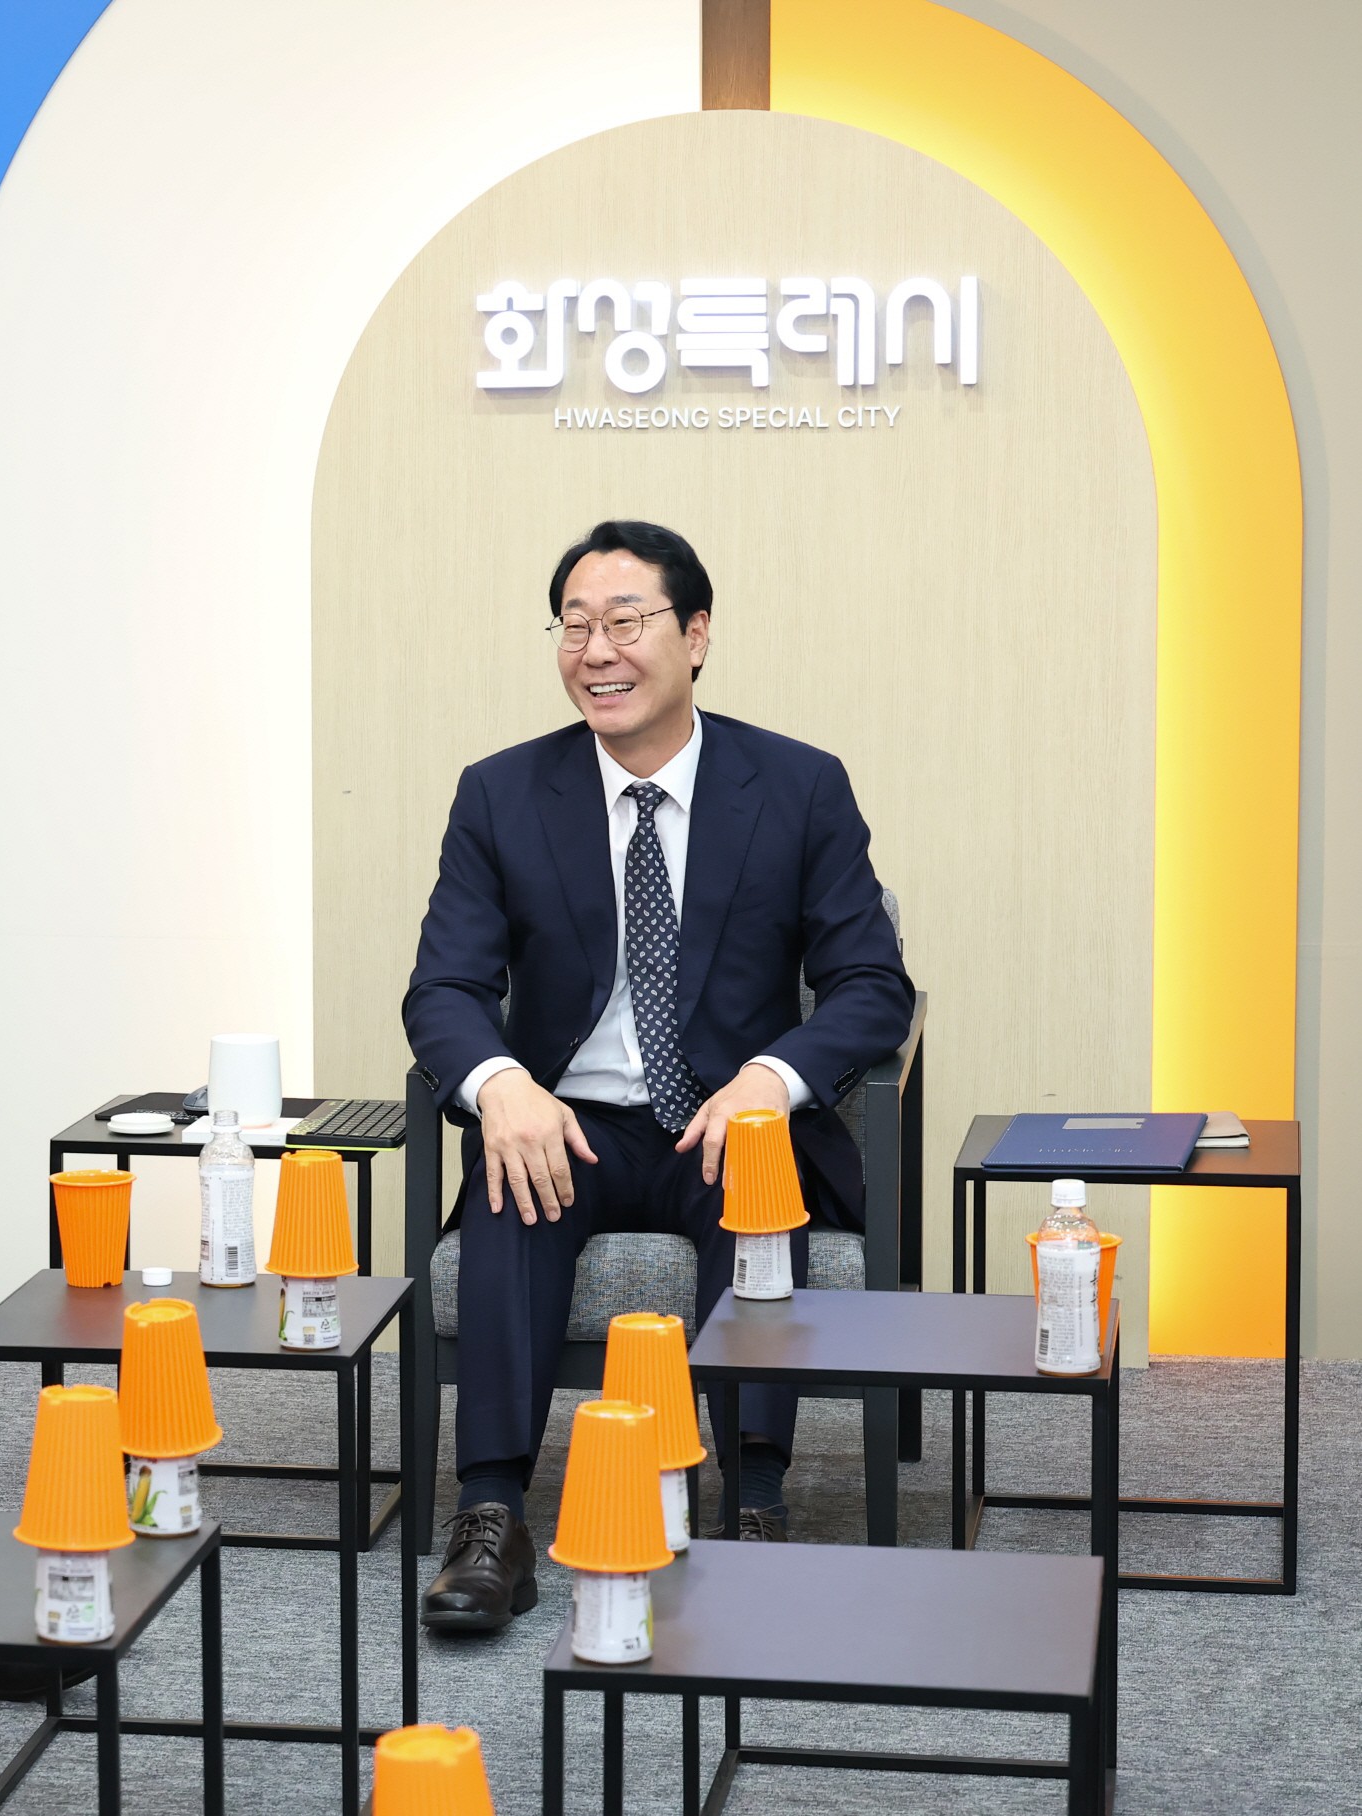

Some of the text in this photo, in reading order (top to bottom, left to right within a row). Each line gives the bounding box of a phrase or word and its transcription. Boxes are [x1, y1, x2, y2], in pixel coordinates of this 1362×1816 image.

[476, 276, 978, 393] 화성특례시
[554, 406, 901, 429] HWASEONG SPECIAL CITY
